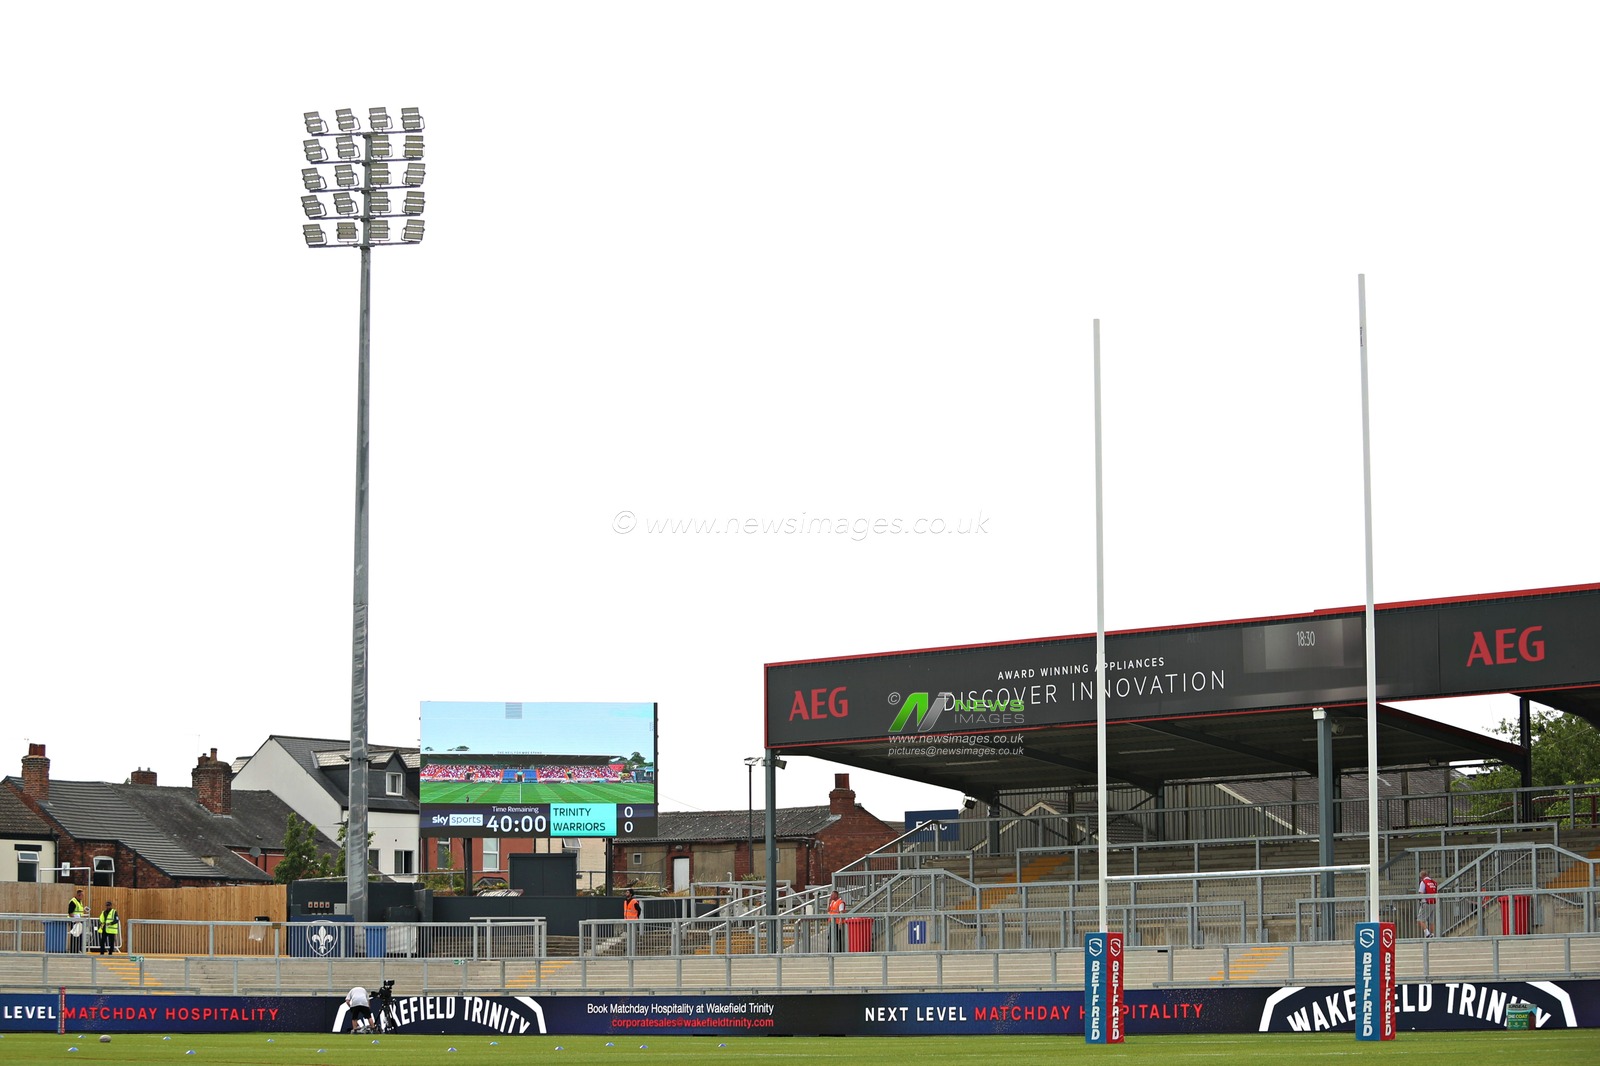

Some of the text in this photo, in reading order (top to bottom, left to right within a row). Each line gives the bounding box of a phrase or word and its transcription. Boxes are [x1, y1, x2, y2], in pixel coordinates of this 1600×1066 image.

[1296, 630, 1316, 646] 18:30
[1466, 625, 1545, 667] AEG
[997, 669, 1035, 680] AWARD
[1040, 664, 1089, 677] WINNING
[788, 686, 849, 721] AEG
[943, 684, 1057, 711] DISCOVER
[508, 806, 539, 814] Remaining
[553, 808, 592, 817] TRINITY
[624, 806, 634, 818] 0
[432, 814, 482, 826] sky sports
[486, 815, 547, 833] 40:00
[553, 822, 606, 832] WARRIORS
[624, 821, 634, 834] 0
[914, 924, 920, 941] 1
[1091, 960, 1100, 1040] BETFRED
[1112, 960, 1120, 1040] BETFRED
[1363, 952, 1373, 1037] BETFRED
[1384, 952, 1392, 1036] BETFRED
[4, 1006, 279, 1021] LEVEL MATCHDAY HOSPITALITY
[463, 996, 530, 1034] TRINITY
[587, 1002, 774, 1016] Book Matchday Hospitality at Wakefield Trinity
[865, 1004, 1203, 1022] NEXT LEVEL MATCHDAY HPITALITY
[611, 1017, 774, 1029] corporatesales@wakefieldtrinity.com
